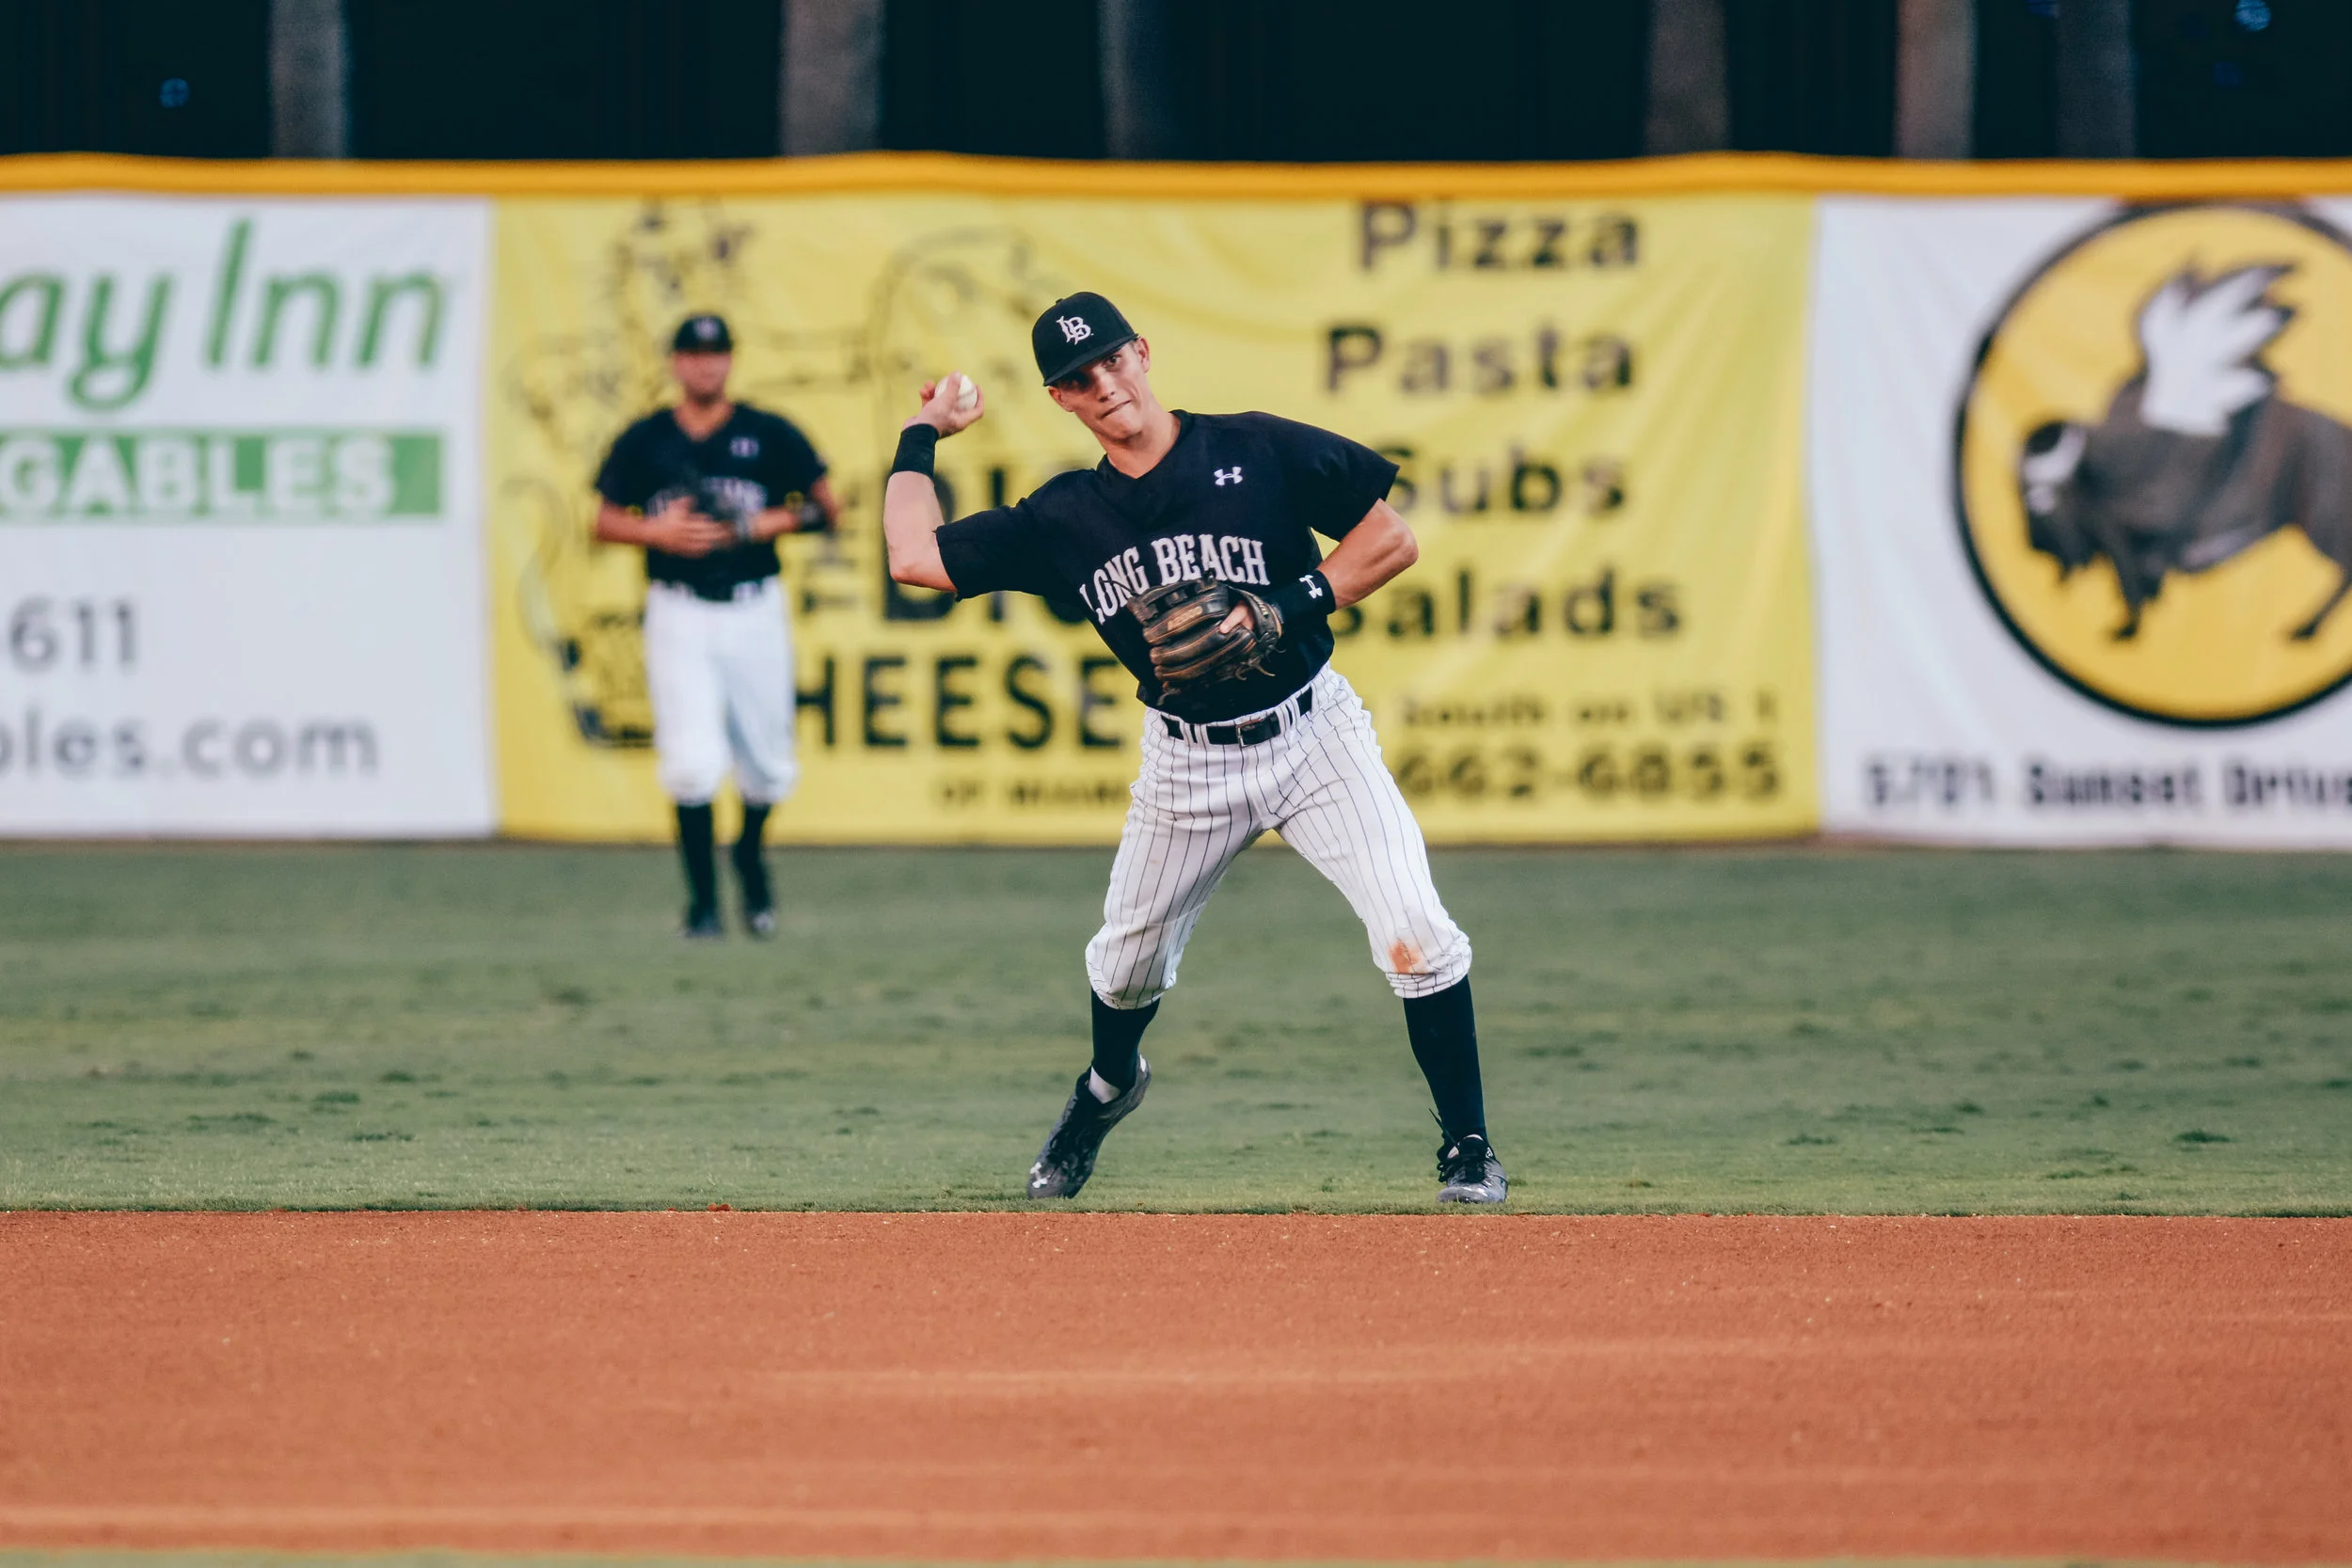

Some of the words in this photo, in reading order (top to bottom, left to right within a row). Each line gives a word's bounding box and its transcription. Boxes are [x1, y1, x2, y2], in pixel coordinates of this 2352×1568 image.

[1359, 199, 1641, 271] Pizza
[203, 217, 448, 372] Inn
[1056, 315, 1091, 345] LB
[1325, 323, 1635, 392] Pasta
[0, 435, 396, 514] GABLES
[1079, 546, 1150, 626] LONG
[1151, 533, 1270, 585] BEACH
[0, 594, 139, 674] 611
[795, 653, 1125, 749] HEESE
